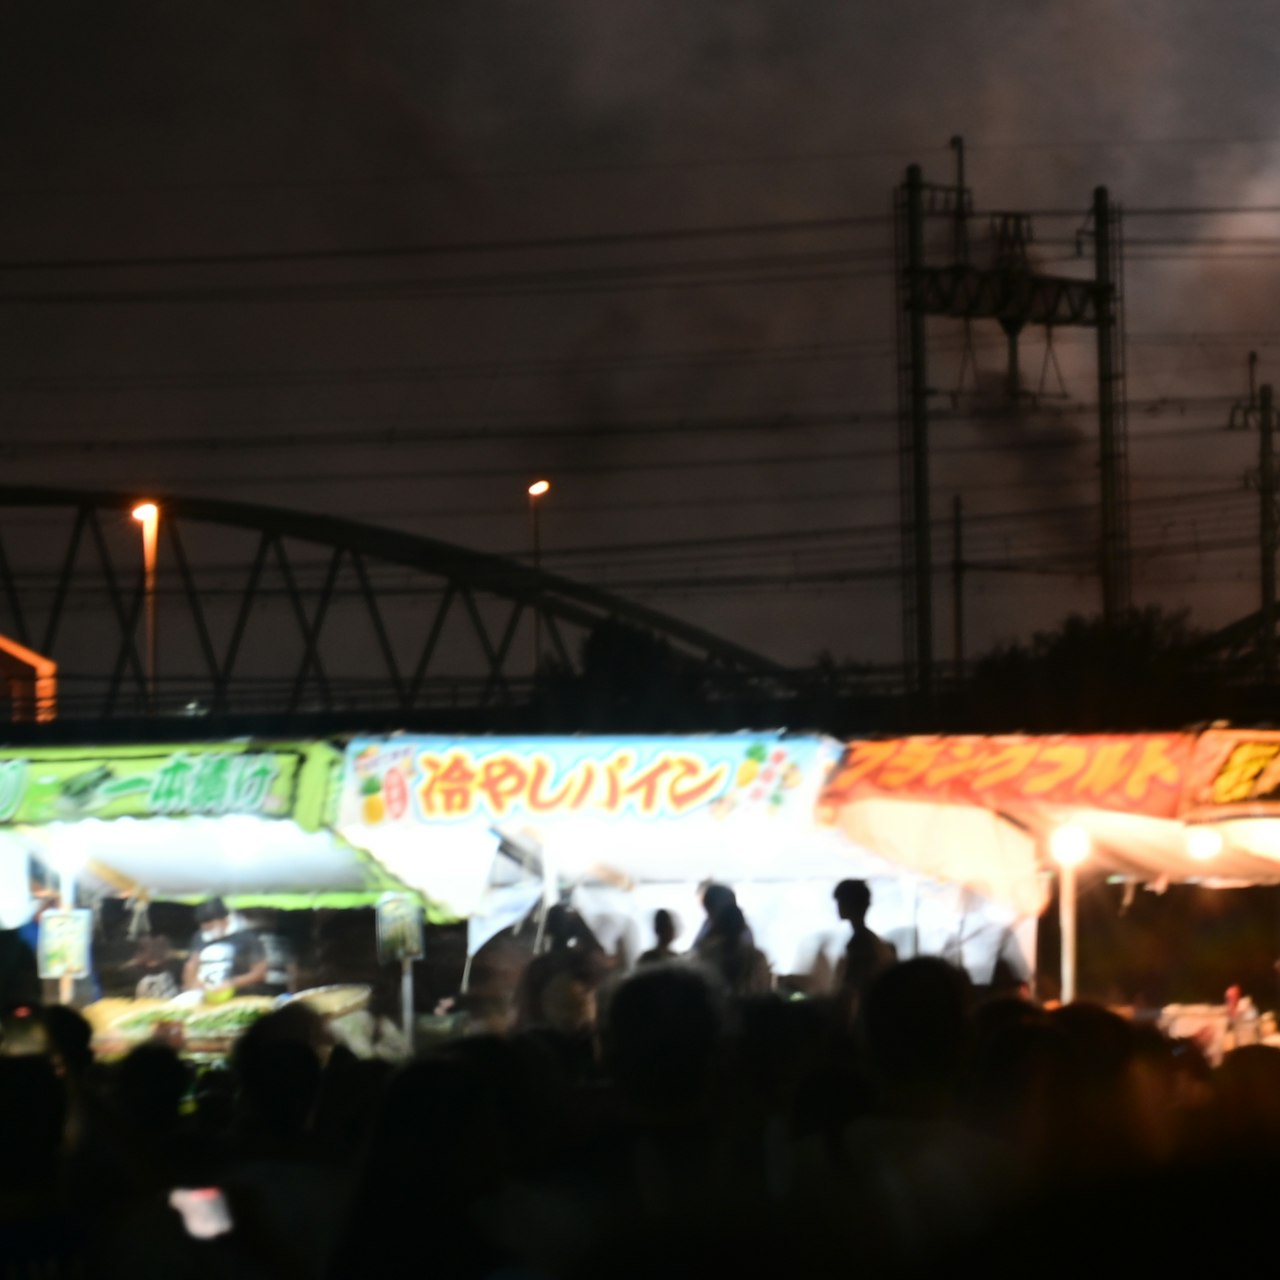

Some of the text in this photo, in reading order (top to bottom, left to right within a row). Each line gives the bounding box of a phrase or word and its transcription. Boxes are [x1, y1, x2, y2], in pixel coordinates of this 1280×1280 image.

[419, 754, 730, 815] 冷やしパイン
[833, 739, 1181, 800] フランクフルト
